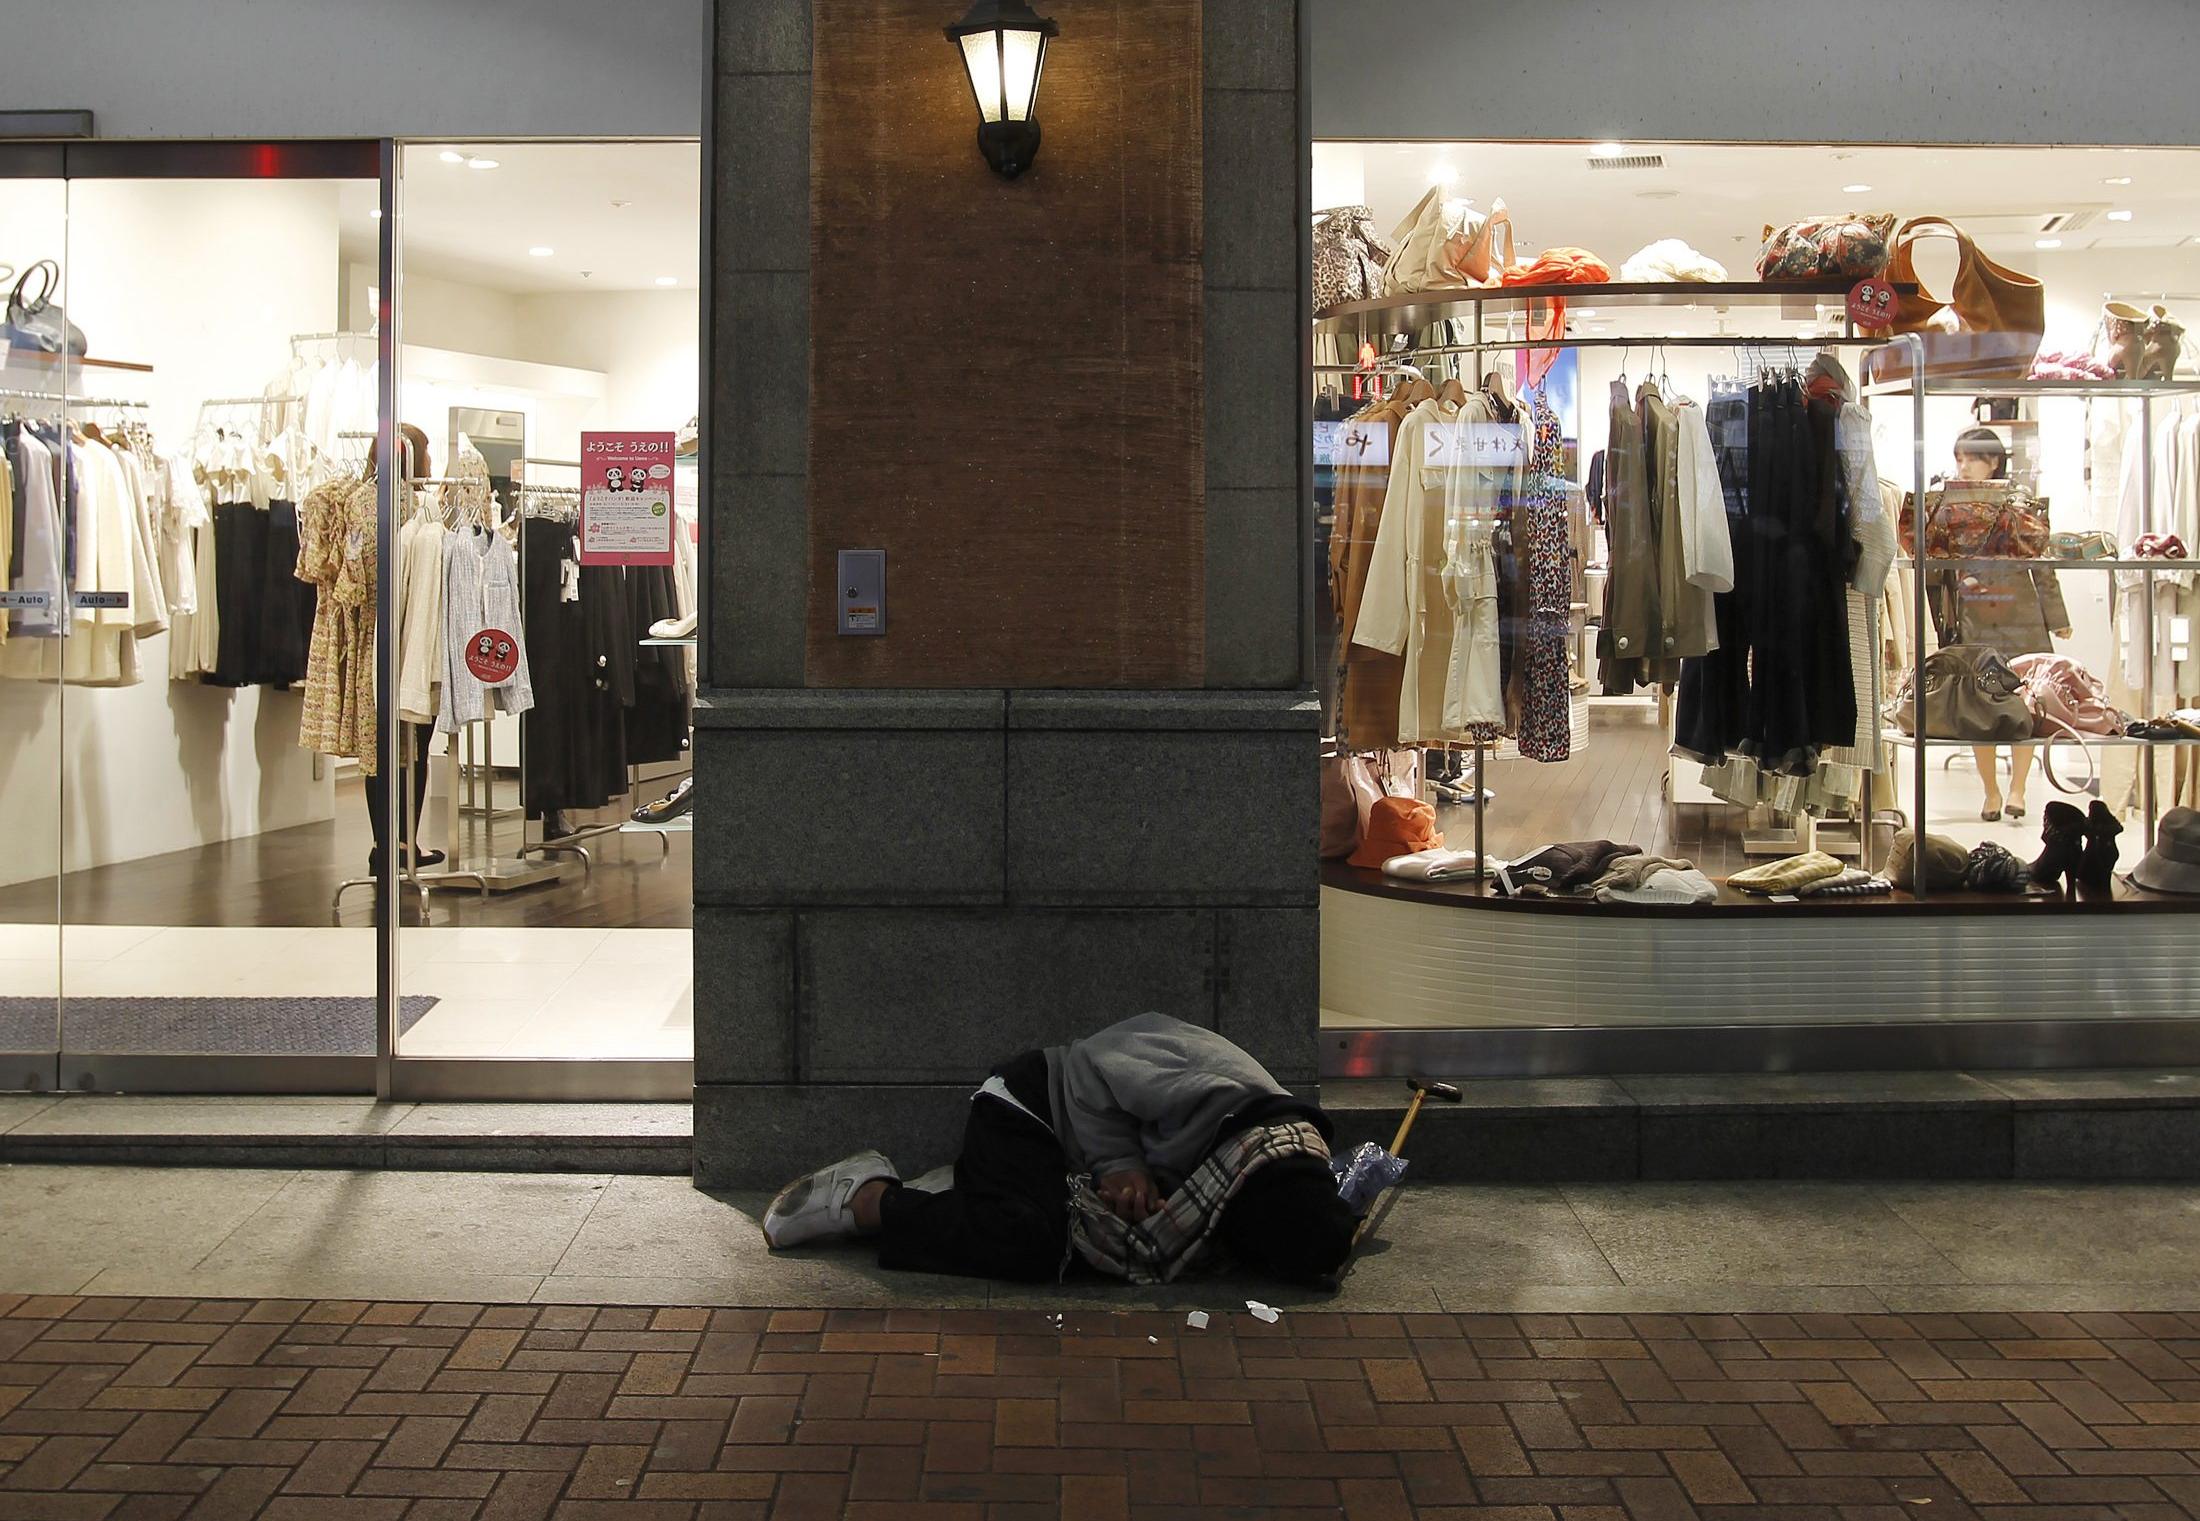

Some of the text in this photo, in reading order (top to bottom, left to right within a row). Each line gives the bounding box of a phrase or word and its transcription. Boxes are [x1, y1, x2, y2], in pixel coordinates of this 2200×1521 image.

[586, 441, 669, 453] ようこそ うえの!!
[18, 595, 105, 604] Auto Auto
[468, 655, 489, 665] ようこそ
